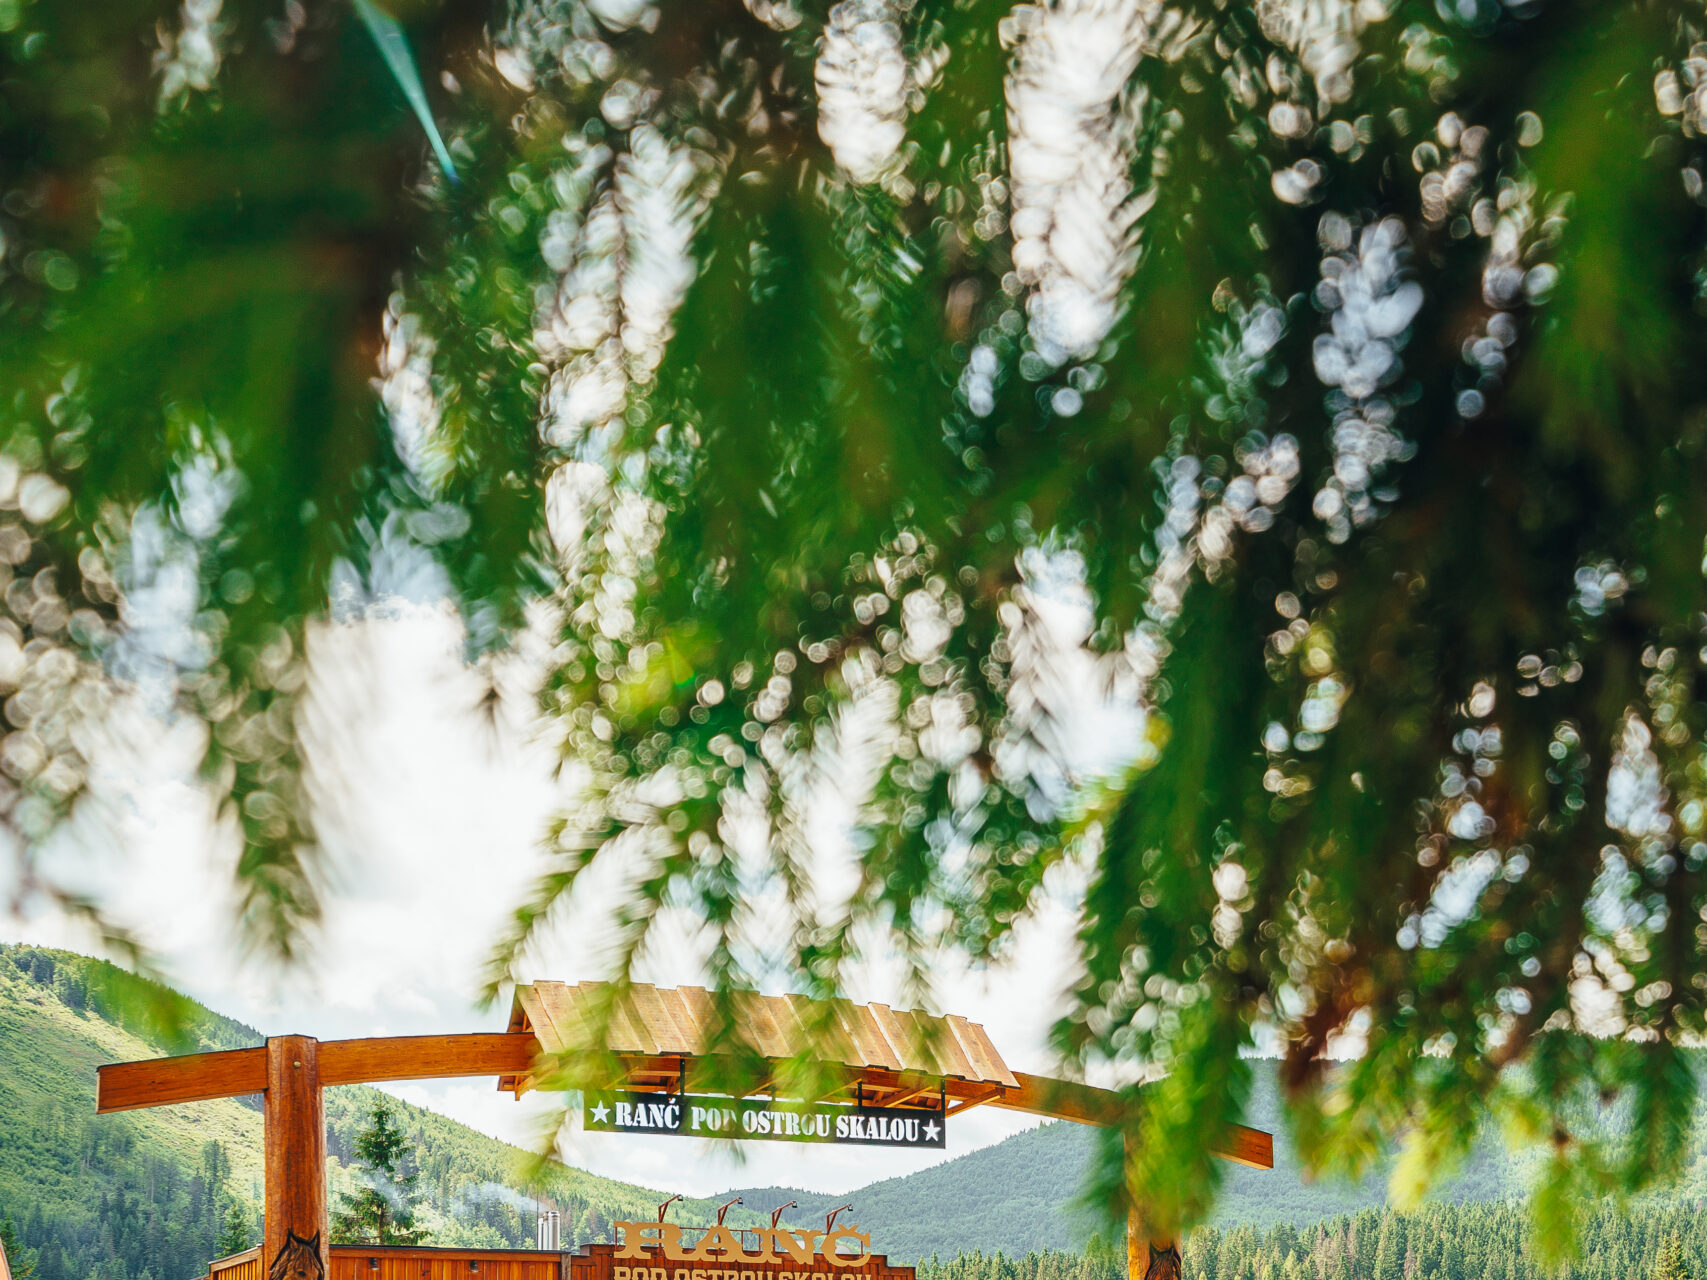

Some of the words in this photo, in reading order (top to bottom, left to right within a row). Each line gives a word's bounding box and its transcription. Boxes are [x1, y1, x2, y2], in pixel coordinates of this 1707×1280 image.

[615, 1098, 680, 1129] RANČ
[691, 1106, 737, 1132] POD
[742, 1110, 829, 1137] OSTROU
[836, 1114, 919, 1142] SKALOU
[613, 1221, 871, 1267] RANČ
